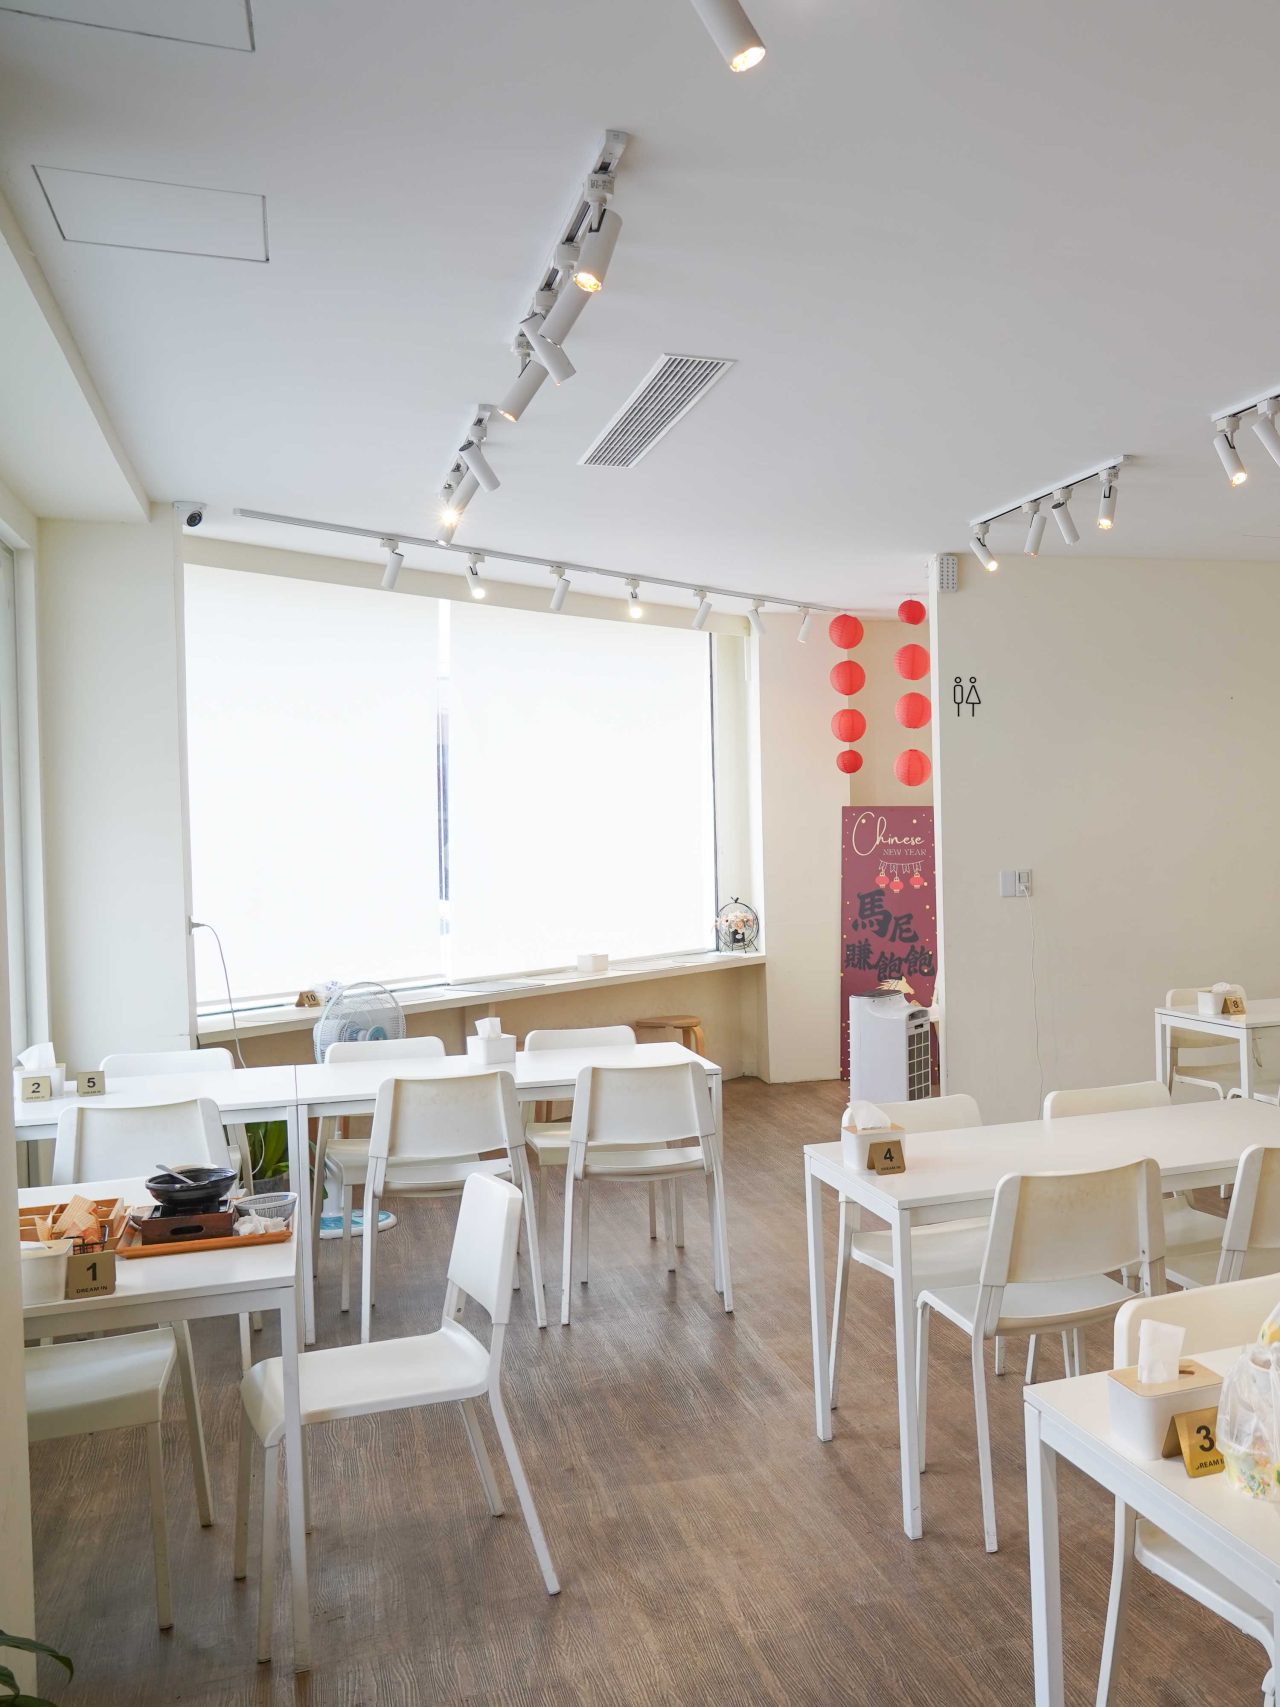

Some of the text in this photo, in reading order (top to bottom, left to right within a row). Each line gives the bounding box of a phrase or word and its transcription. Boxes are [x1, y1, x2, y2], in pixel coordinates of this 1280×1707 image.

[853, 811, 924, 856] Chinese
[883, 848, 926, 856] NEW YEAR
[851, 888, 919, 943] 馬尼
[844, 938, 936, 982] 賺飽飽
[305, 993, 316, 1002] 10
[31, 1082, 41, 1094] 2
[87, 1077, 96, 1088] 5
[883, 1148, 894, 1162] 4
[86, 1262, 97, 1281] 1
[76, 1286, 100, 1294] DREAM
[1196, 1424, 1215, 1452] 3
